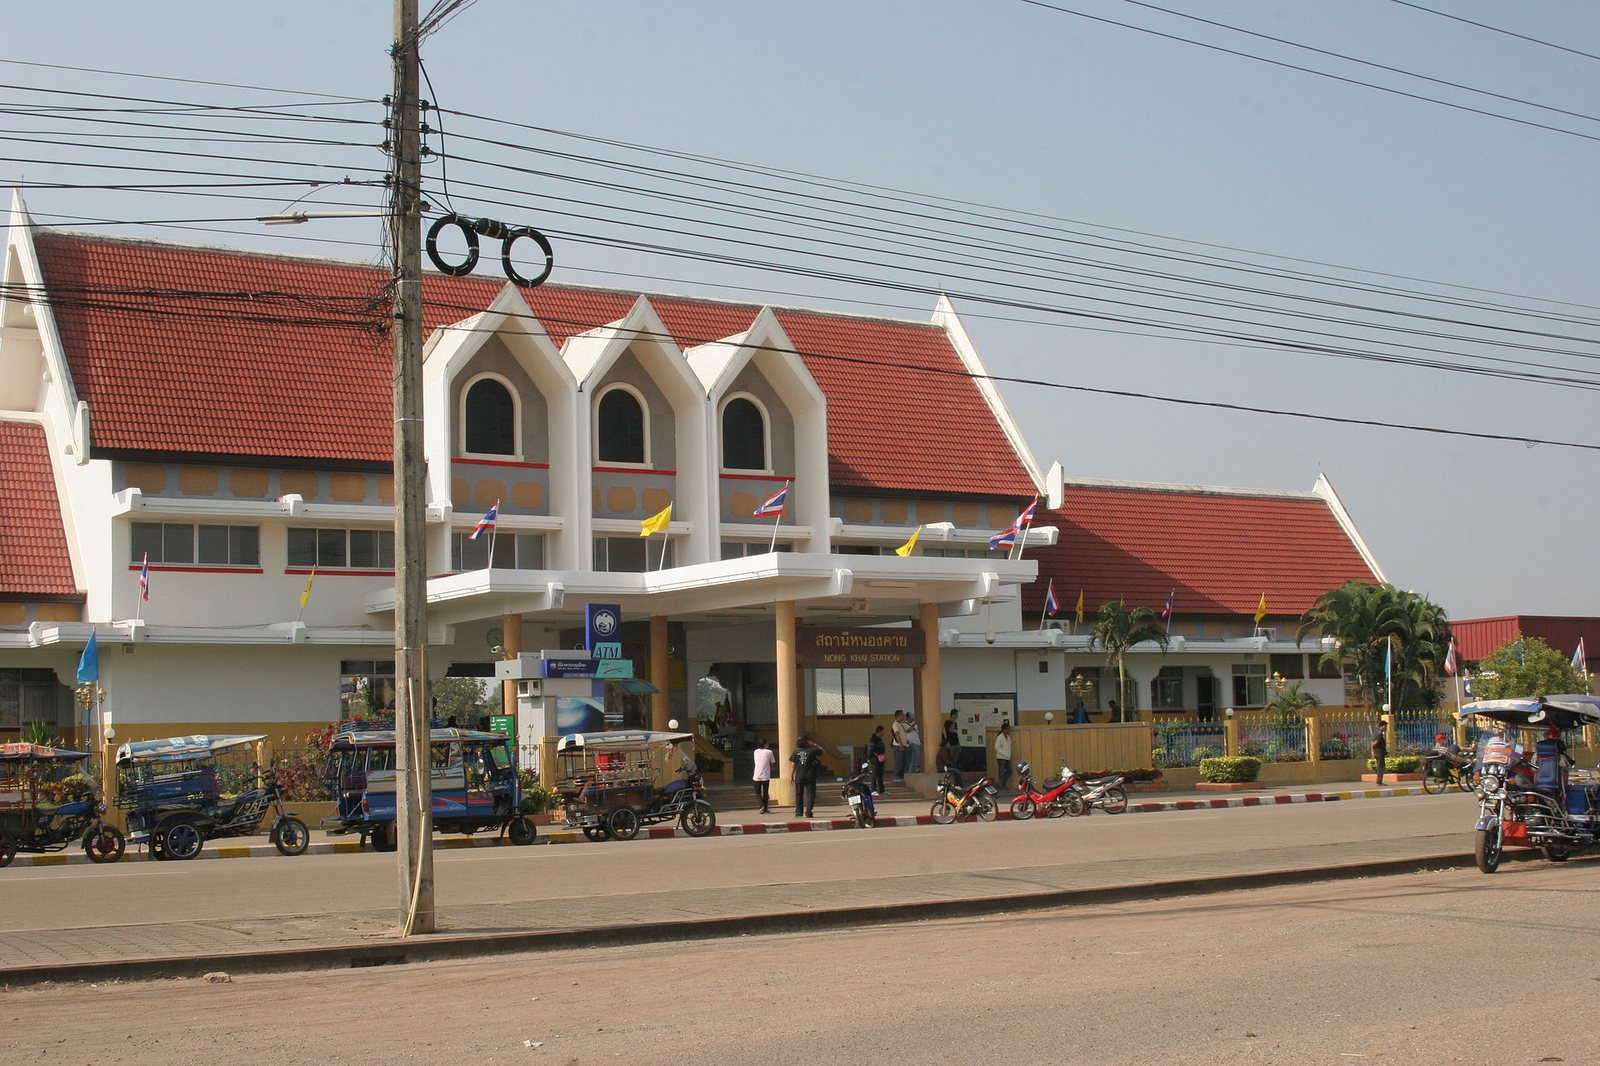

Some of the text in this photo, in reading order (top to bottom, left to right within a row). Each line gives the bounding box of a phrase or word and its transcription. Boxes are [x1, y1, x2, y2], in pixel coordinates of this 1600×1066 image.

[594, 646, 619, 658] ATM
[824, 654, 900, 662] NONG KHAI STATION
